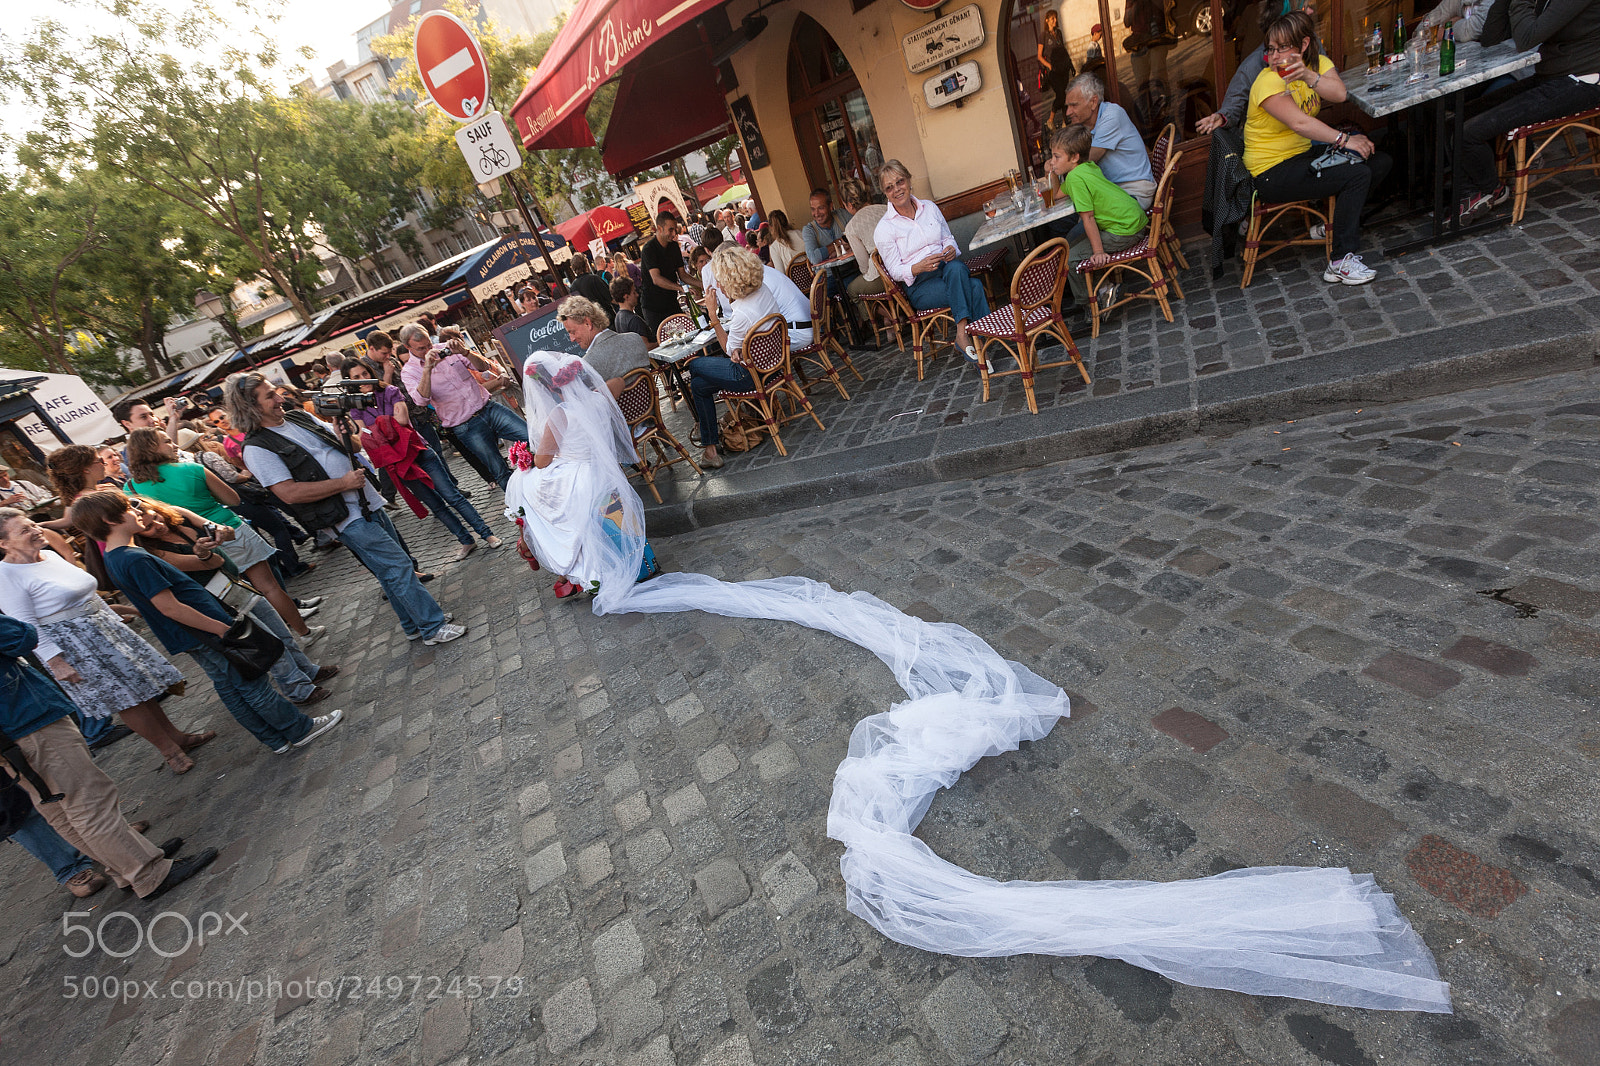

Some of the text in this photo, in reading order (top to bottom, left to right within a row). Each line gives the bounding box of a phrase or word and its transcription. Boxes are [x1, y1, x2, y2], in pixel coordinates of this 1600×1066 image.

[907, 10, 971, 45] STATIONNEMENT GÊNANT
[586, 17, 652, 90] La Bohème
[467, 121, 492, 144] SAUF
[479, 265, 489, 279] AU
[486, 243, 509, 268] CLAIRON
[24, 402, 101, 436] RESAURANT
[41, 394, 73, 412] AFE
